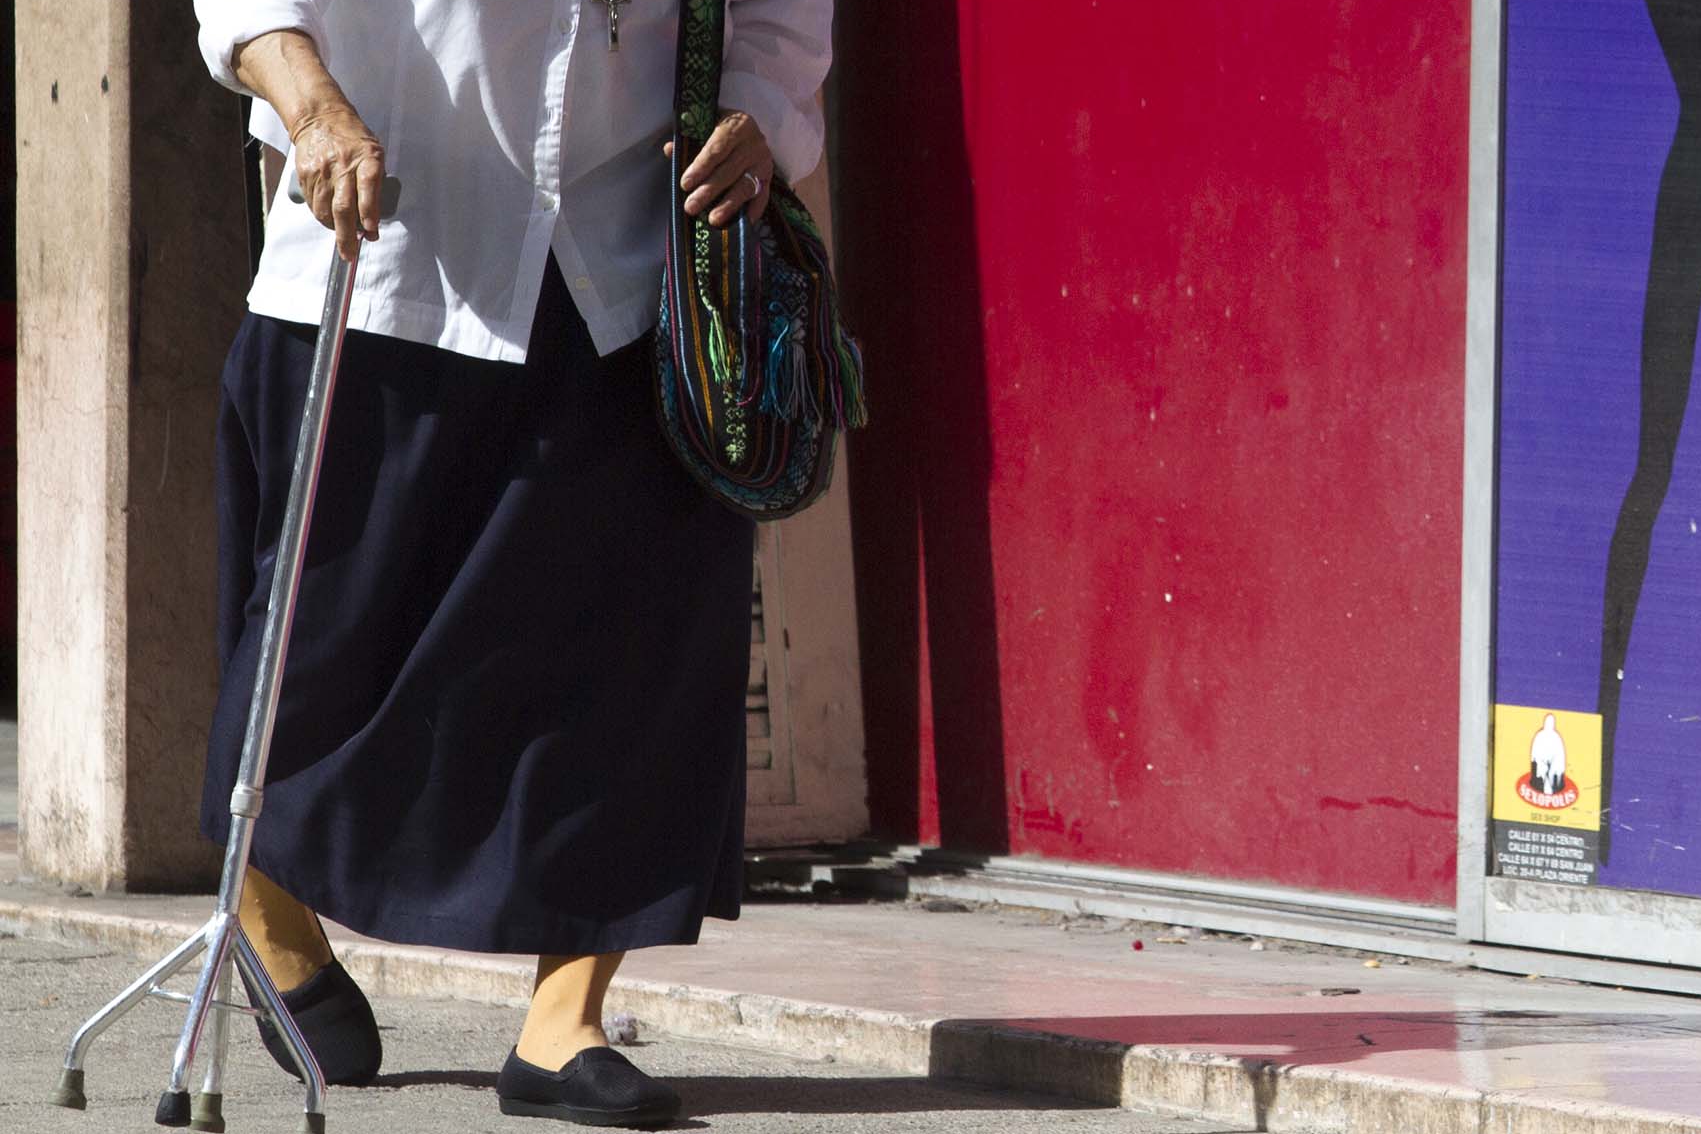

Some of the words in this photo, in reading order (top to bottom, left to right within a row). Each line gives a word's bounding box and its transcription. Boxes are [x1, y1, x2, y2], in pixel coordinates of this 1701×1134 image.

[1519, 783, 1576, 808] SEXOPOLIS
[1507, 829, 1531, 841] CALLE
[1507, 841, 1531, 853] CALLE
[1497, 852, 1521, 865] CALLE
